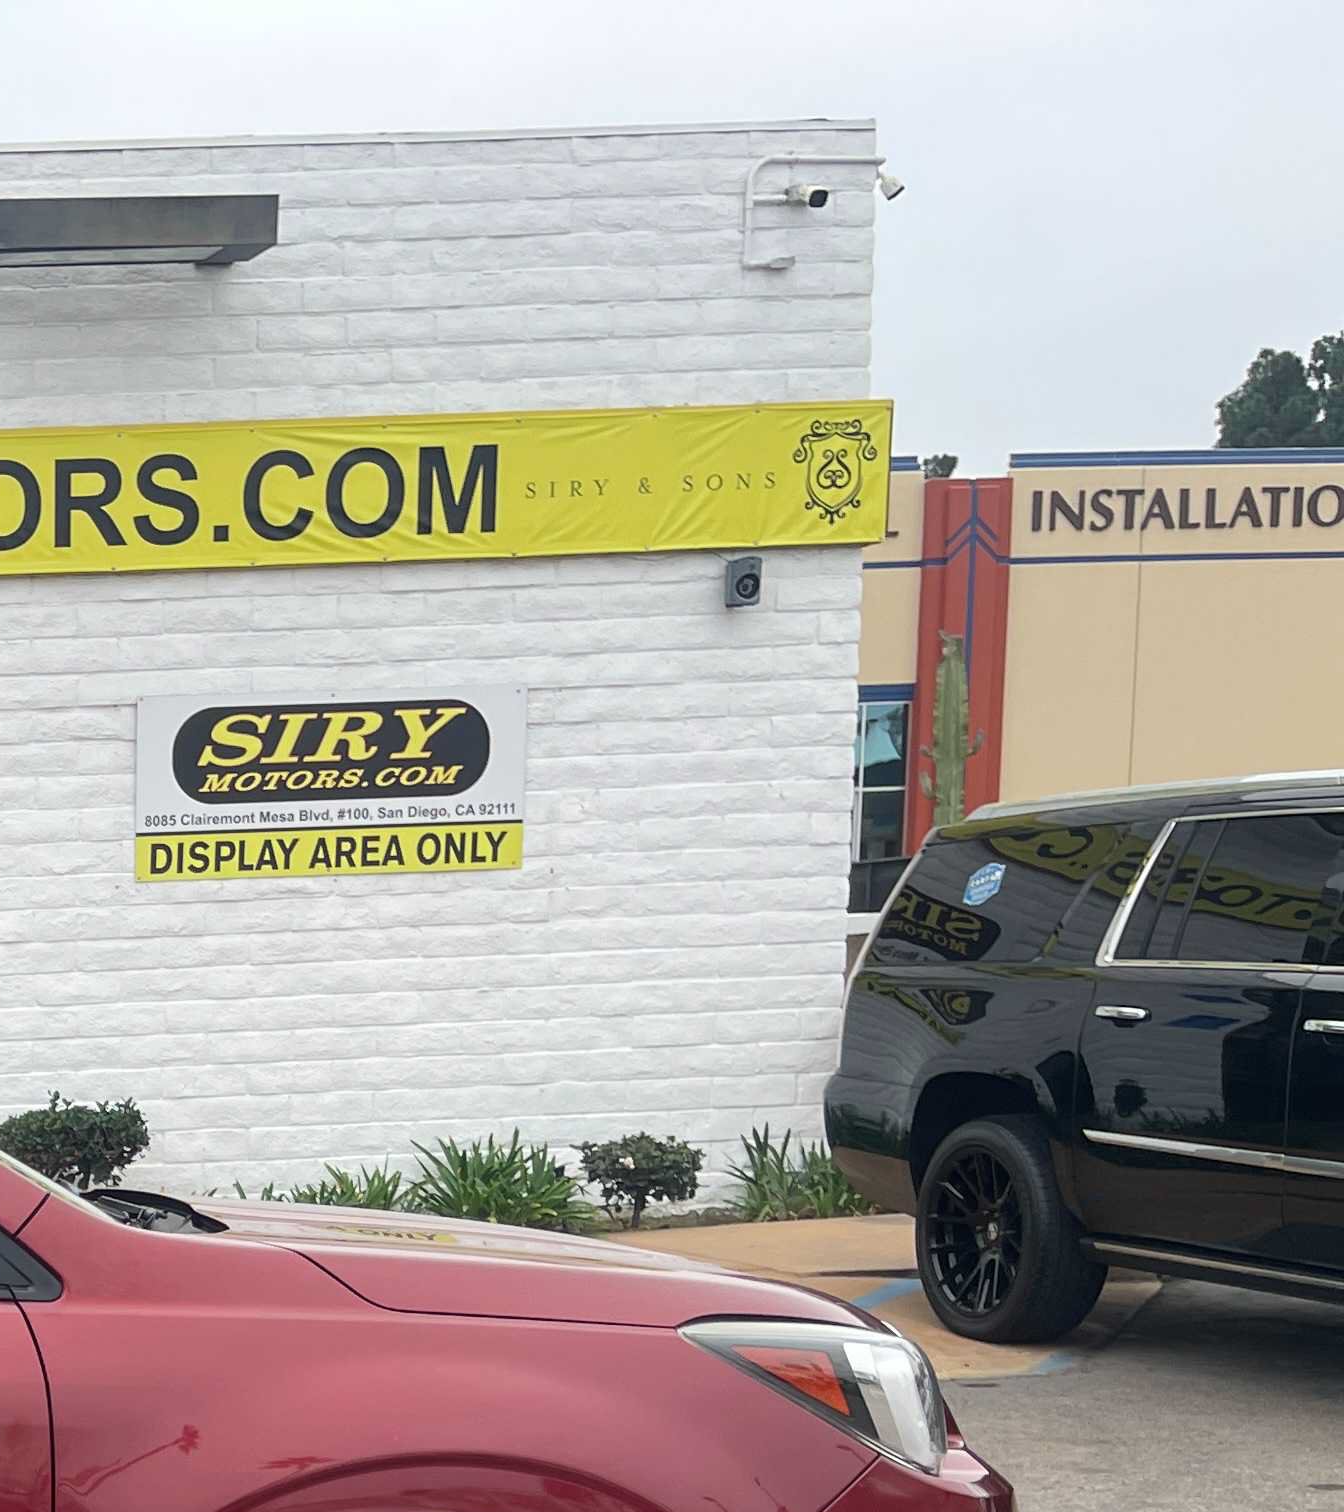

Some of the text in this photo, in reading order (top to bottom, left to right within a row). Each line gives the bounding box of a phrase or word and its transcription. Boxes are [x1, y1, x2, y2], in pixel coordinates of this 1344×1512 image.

[525, 471, 777, 499] SIRY & SONS
[197, 706, 468, 768] SIRY
[198, 764, 464, 794] MOTORS.COM
[144, 815, 177, 828] 8085
[180, 811, 255, 827] Clairemont
[259, 811, 295, 824] Mesa
[299, 809, 334, 823] Blvd,
[377, 807, 403, 820] San
[408, 806, 451, 820] Diego,
[455, 804, 476, 817] CA
[479, 803, 516, 816] 92111
[150, 831, 508, 875] DISPLAY AREA ONLY
